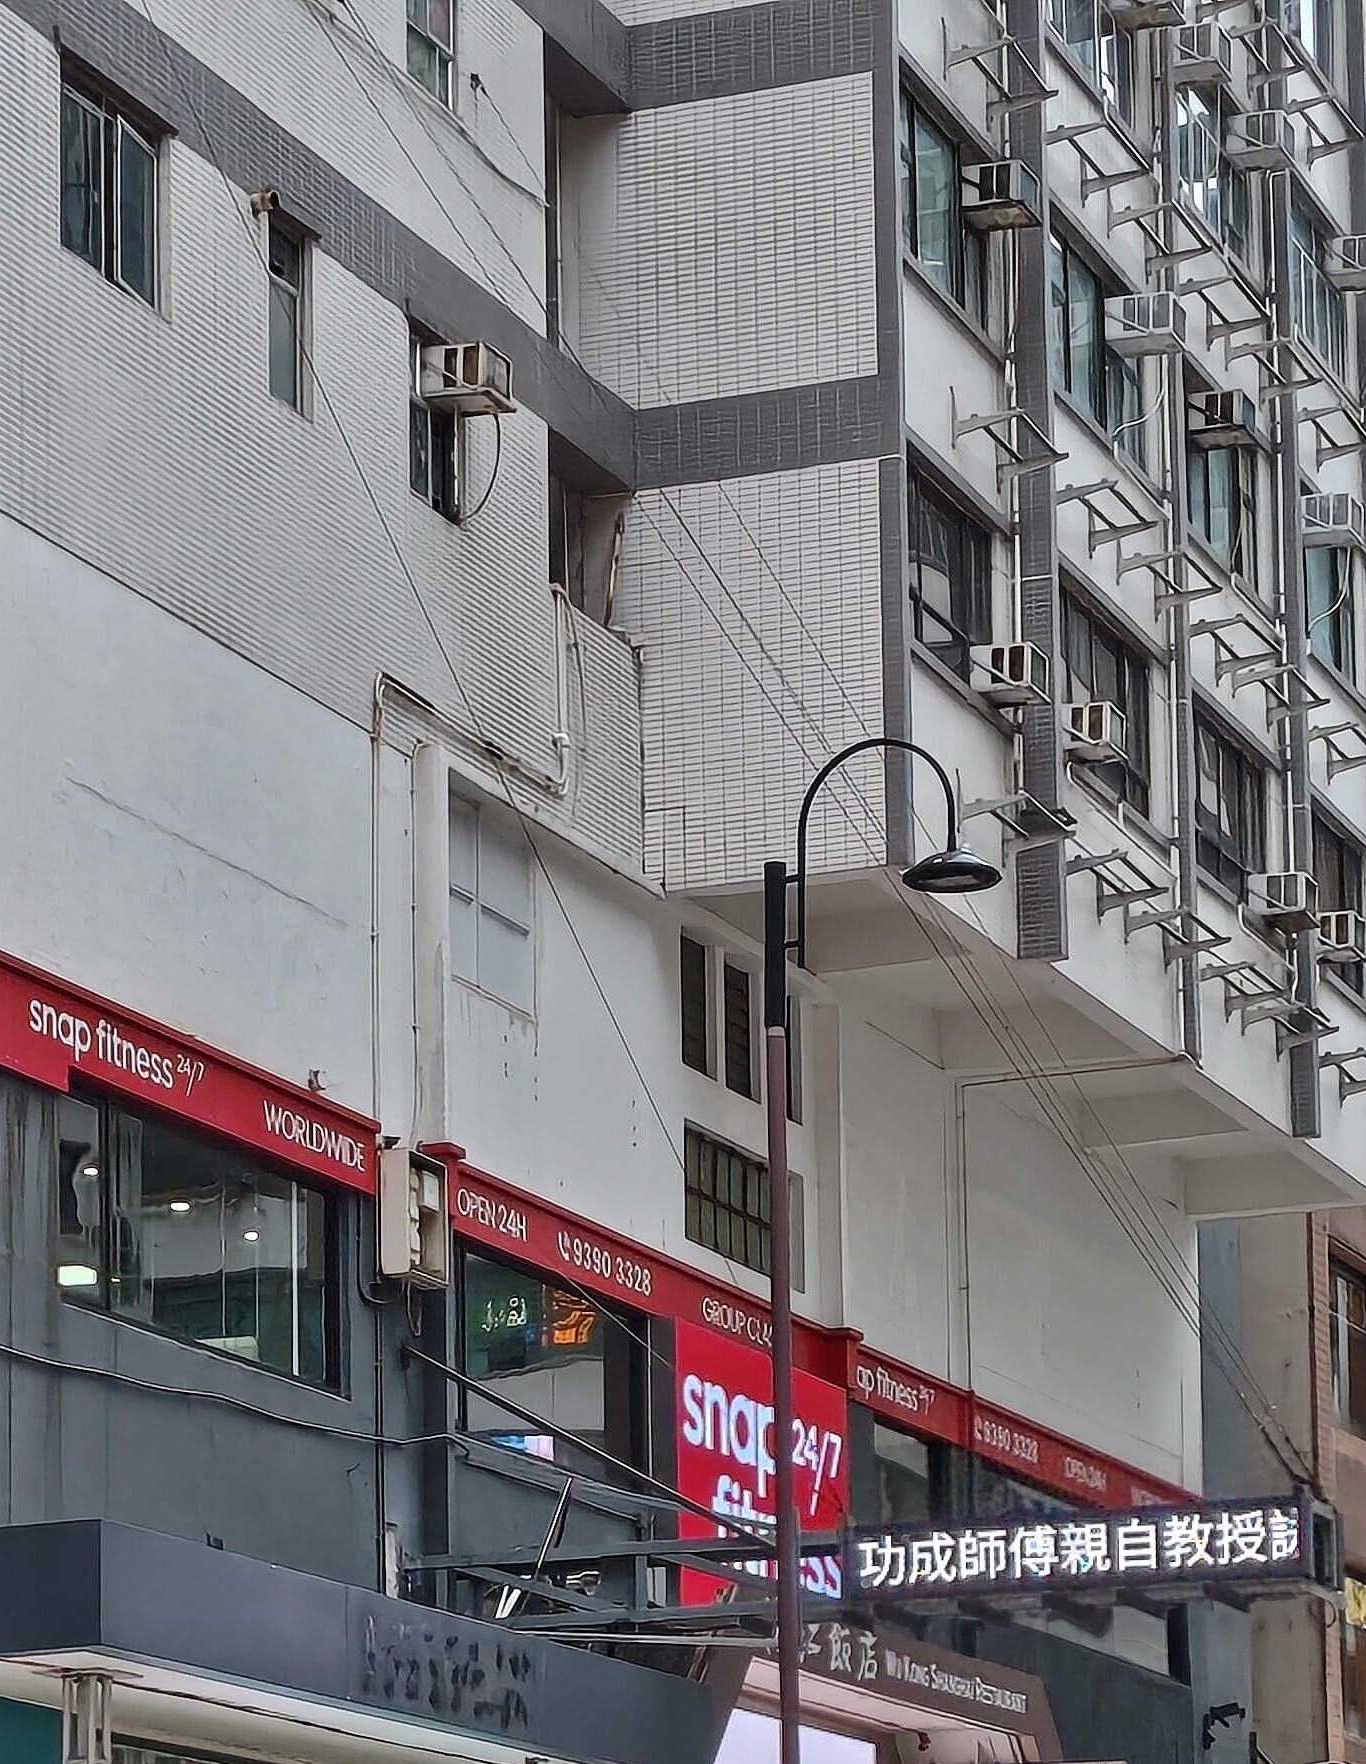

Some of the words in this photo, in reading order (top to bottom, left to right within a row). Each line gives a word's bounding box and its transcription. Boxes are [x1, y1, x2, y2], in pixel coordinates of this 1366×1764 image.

[28, 997, 92, 1061] snap
[96, 1022, 175, 1090] fitness
[176, 1053, 206, 1097] 24/7
[263, 1099, 368, 1173] WORLDWIDE
[457, 1188, 496, 1229] OPEN
[498, 1204, 528, 1243] 24H
[573, 1237, 612, 1279] 9390
[615, 1256, 654, 1297] 3328
[792, 1417, 843, 1516] 24/7
